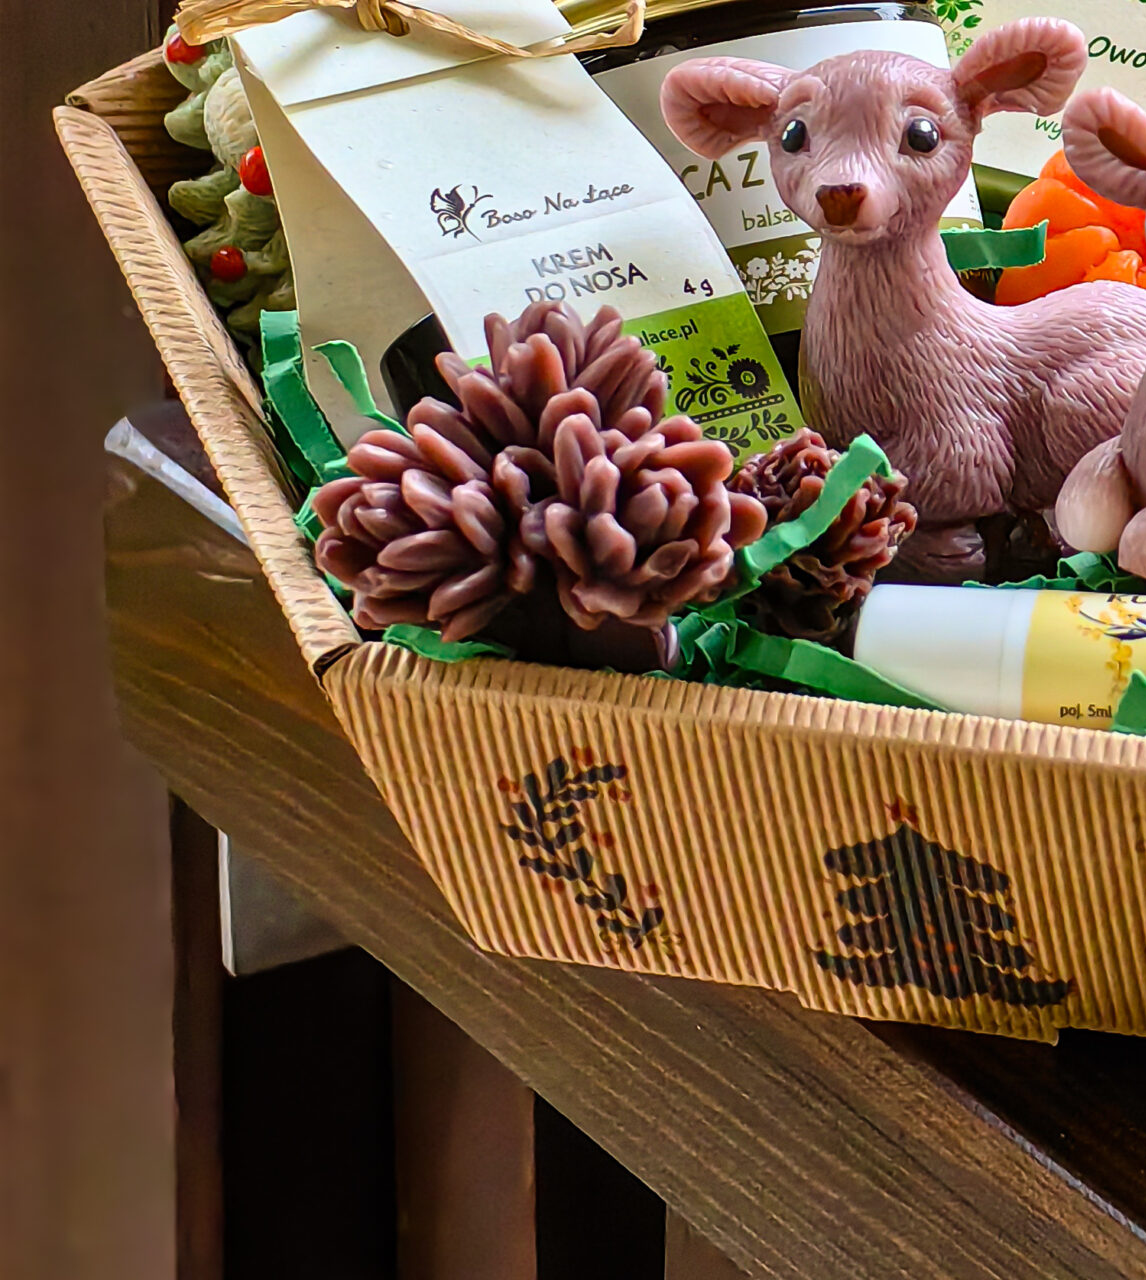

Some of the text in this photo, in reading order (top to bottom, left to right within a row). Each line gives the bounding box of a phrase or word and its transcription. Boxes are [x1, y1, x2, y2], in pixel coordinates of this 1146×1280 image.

[737, 151, 765, 188] Z
[481, 210, 537, 228] Boso
[544, 192, 579, 215] Na
[742, 204, 798, 231] balsa
[532, 243, 613, 278] KREM
[525, 262, 648, 303] DO NOSA
[683, 278, 714, 297] 4 g
[1088, 704, 1112, 718] 5ml
